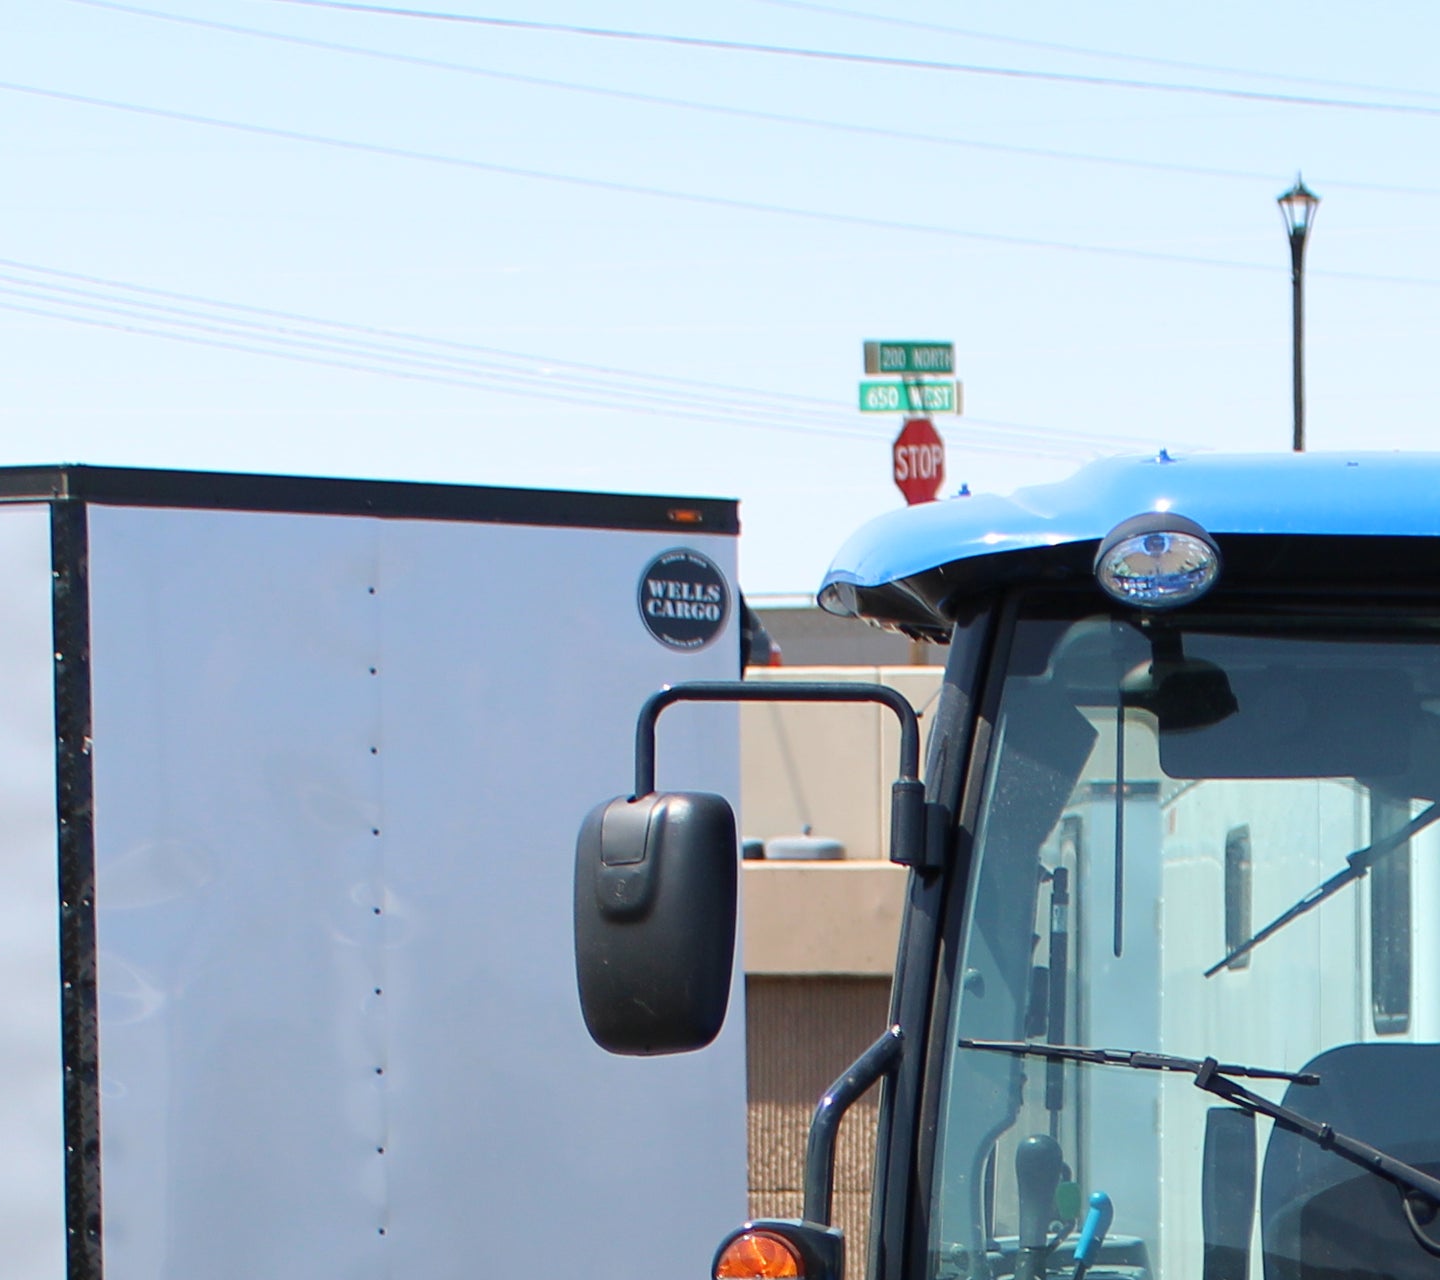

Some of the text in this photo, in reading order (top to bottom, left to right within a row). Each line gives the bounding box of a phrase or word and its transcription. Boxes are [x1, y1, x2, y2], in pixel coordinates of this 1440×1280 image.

[882, 346, 953, 369] 200 NORTH
[867, 385, 952, 408] 650 WEST
[895, 444, 944, 480] STOP
[647, 579, 721, 603] WELLS
[647, 599, 721, 622] CARGO
